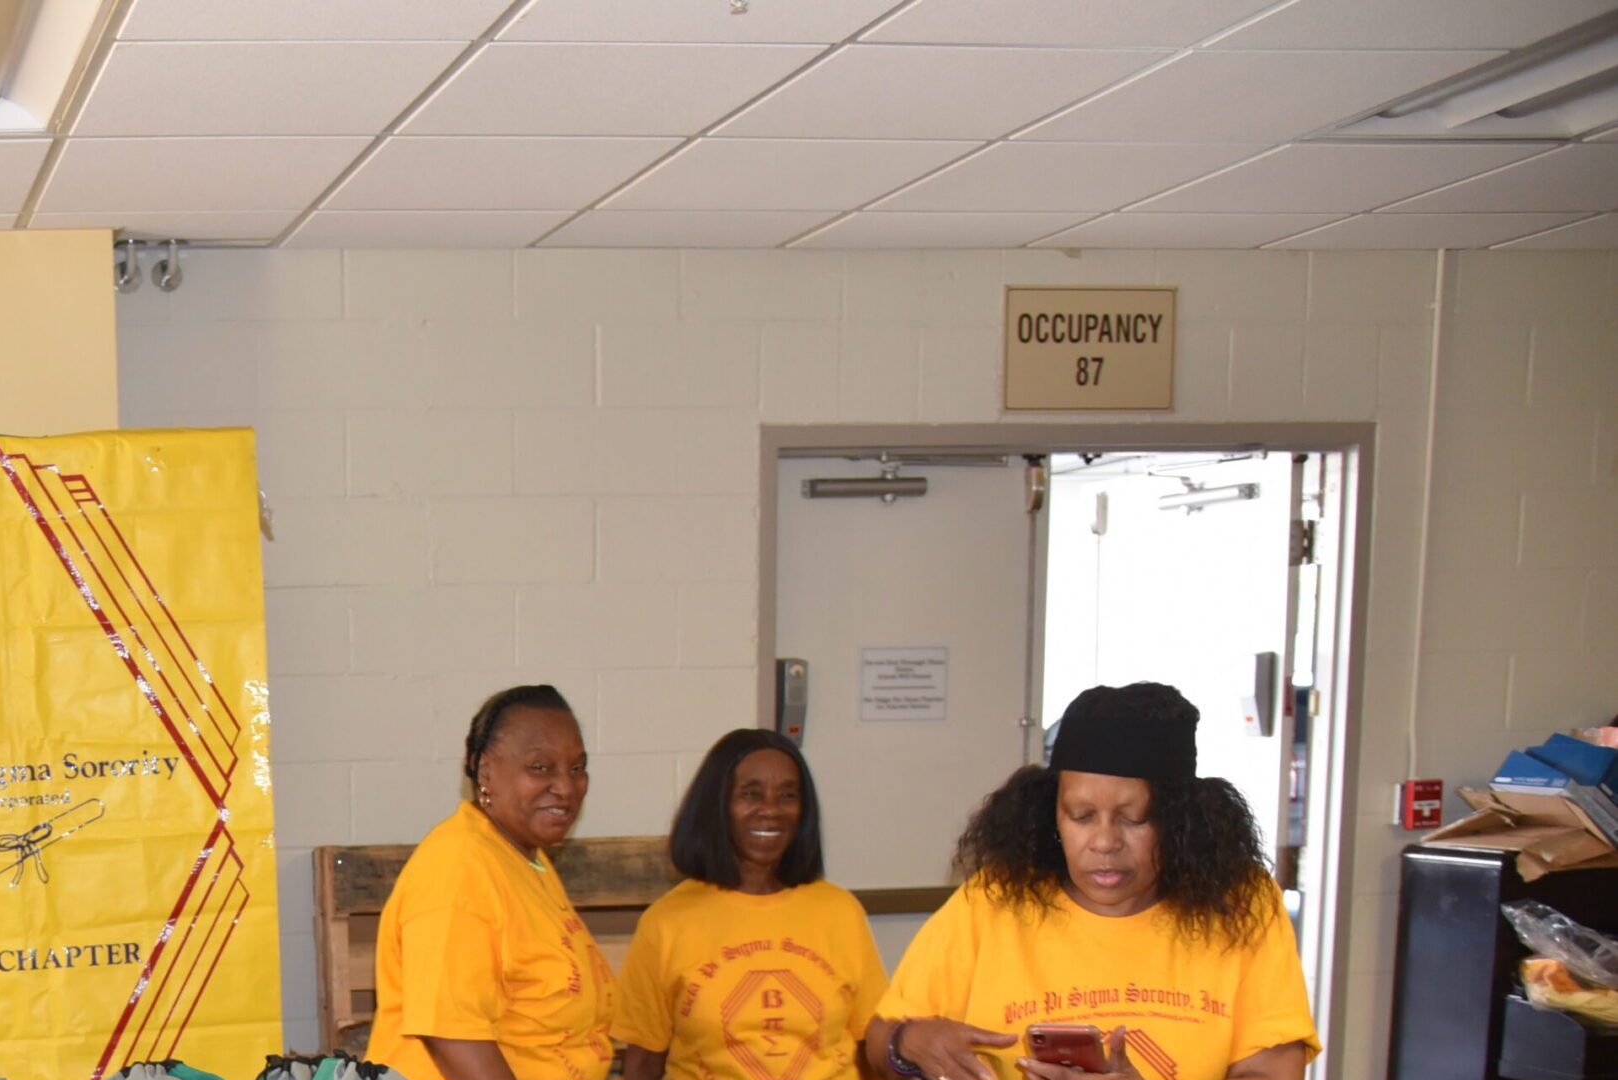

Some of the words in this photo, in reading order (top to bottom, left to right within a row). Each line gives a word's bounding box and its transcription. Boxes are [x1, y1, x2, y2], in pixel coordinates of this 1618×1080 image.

[1017, 312, 1163, 344] OCCUPANCY
[1075, 356, 1105, 387] 87
[63, 750, 179, 780] Sorority
